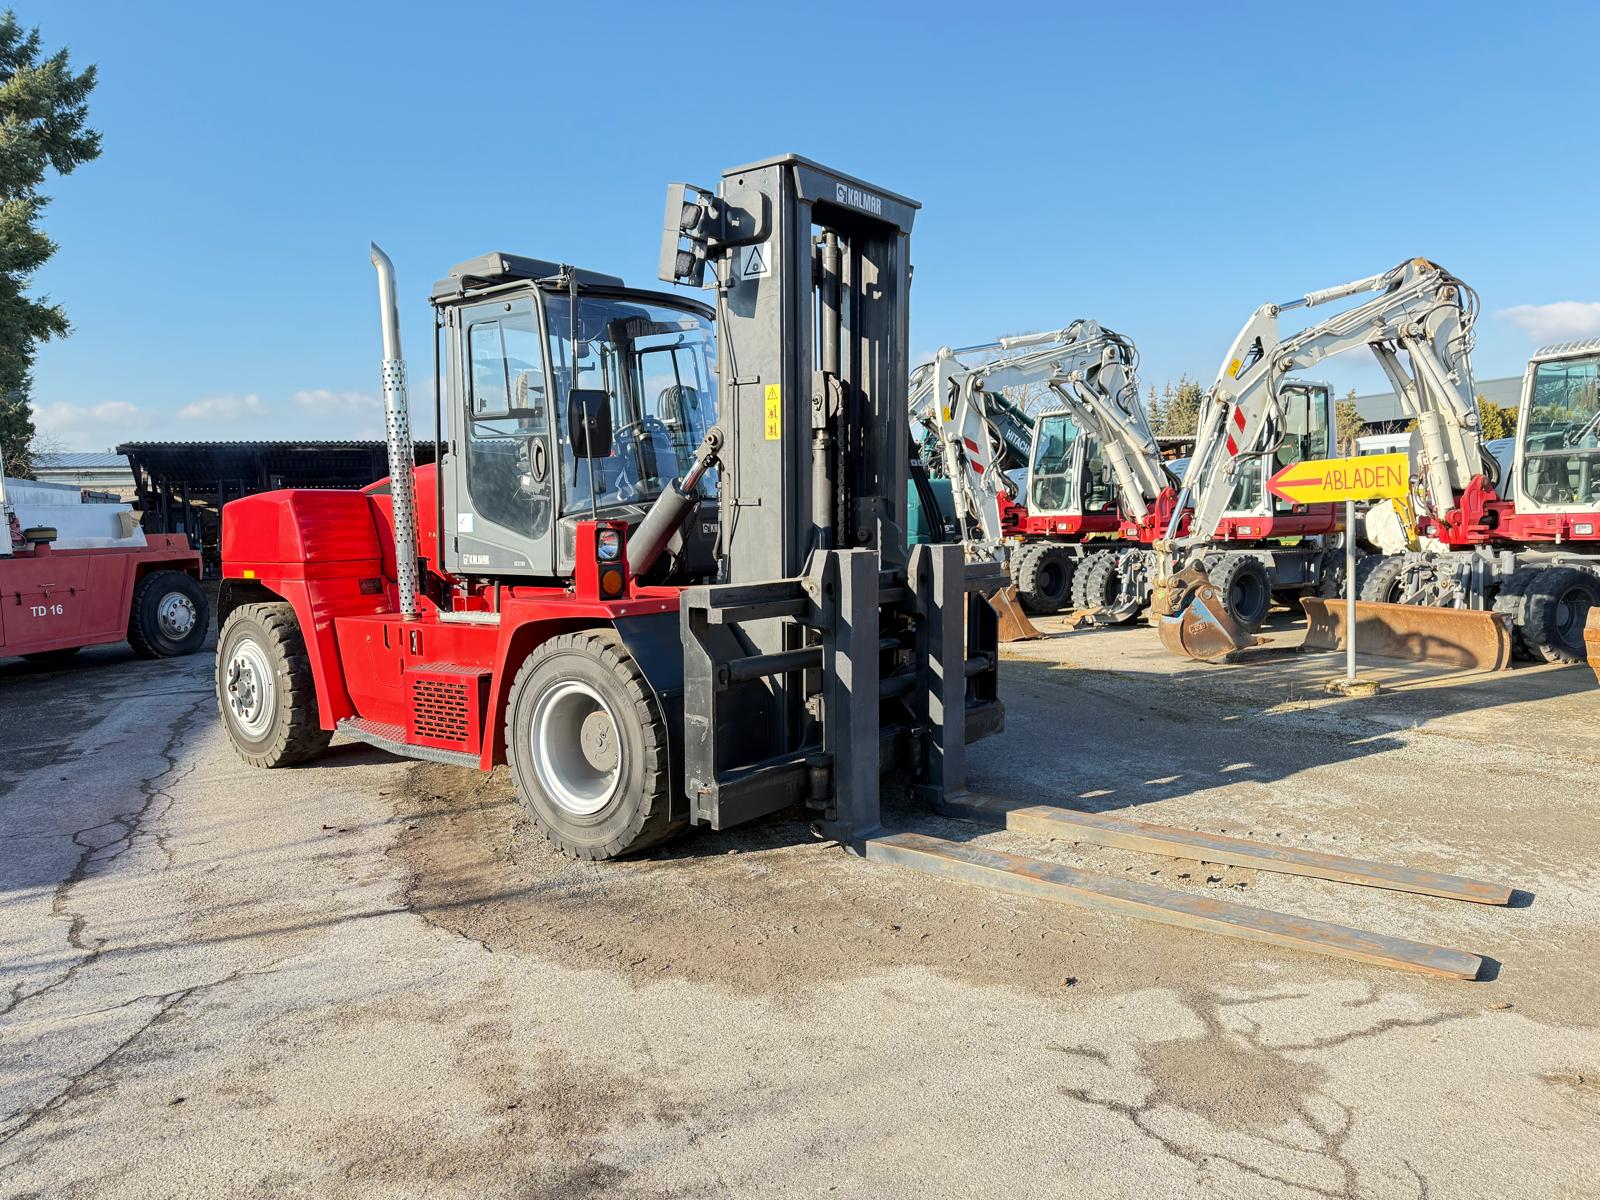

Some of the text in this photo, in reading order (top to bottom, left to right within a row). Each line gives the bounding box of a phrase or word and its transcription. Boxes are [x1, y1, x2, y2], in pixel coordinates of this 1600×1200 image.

[848, 188, 881, 215] KALMAR
[1323, 464, 1402, 491] ABLADEN
[30, 604, 63, 617] TD 16
